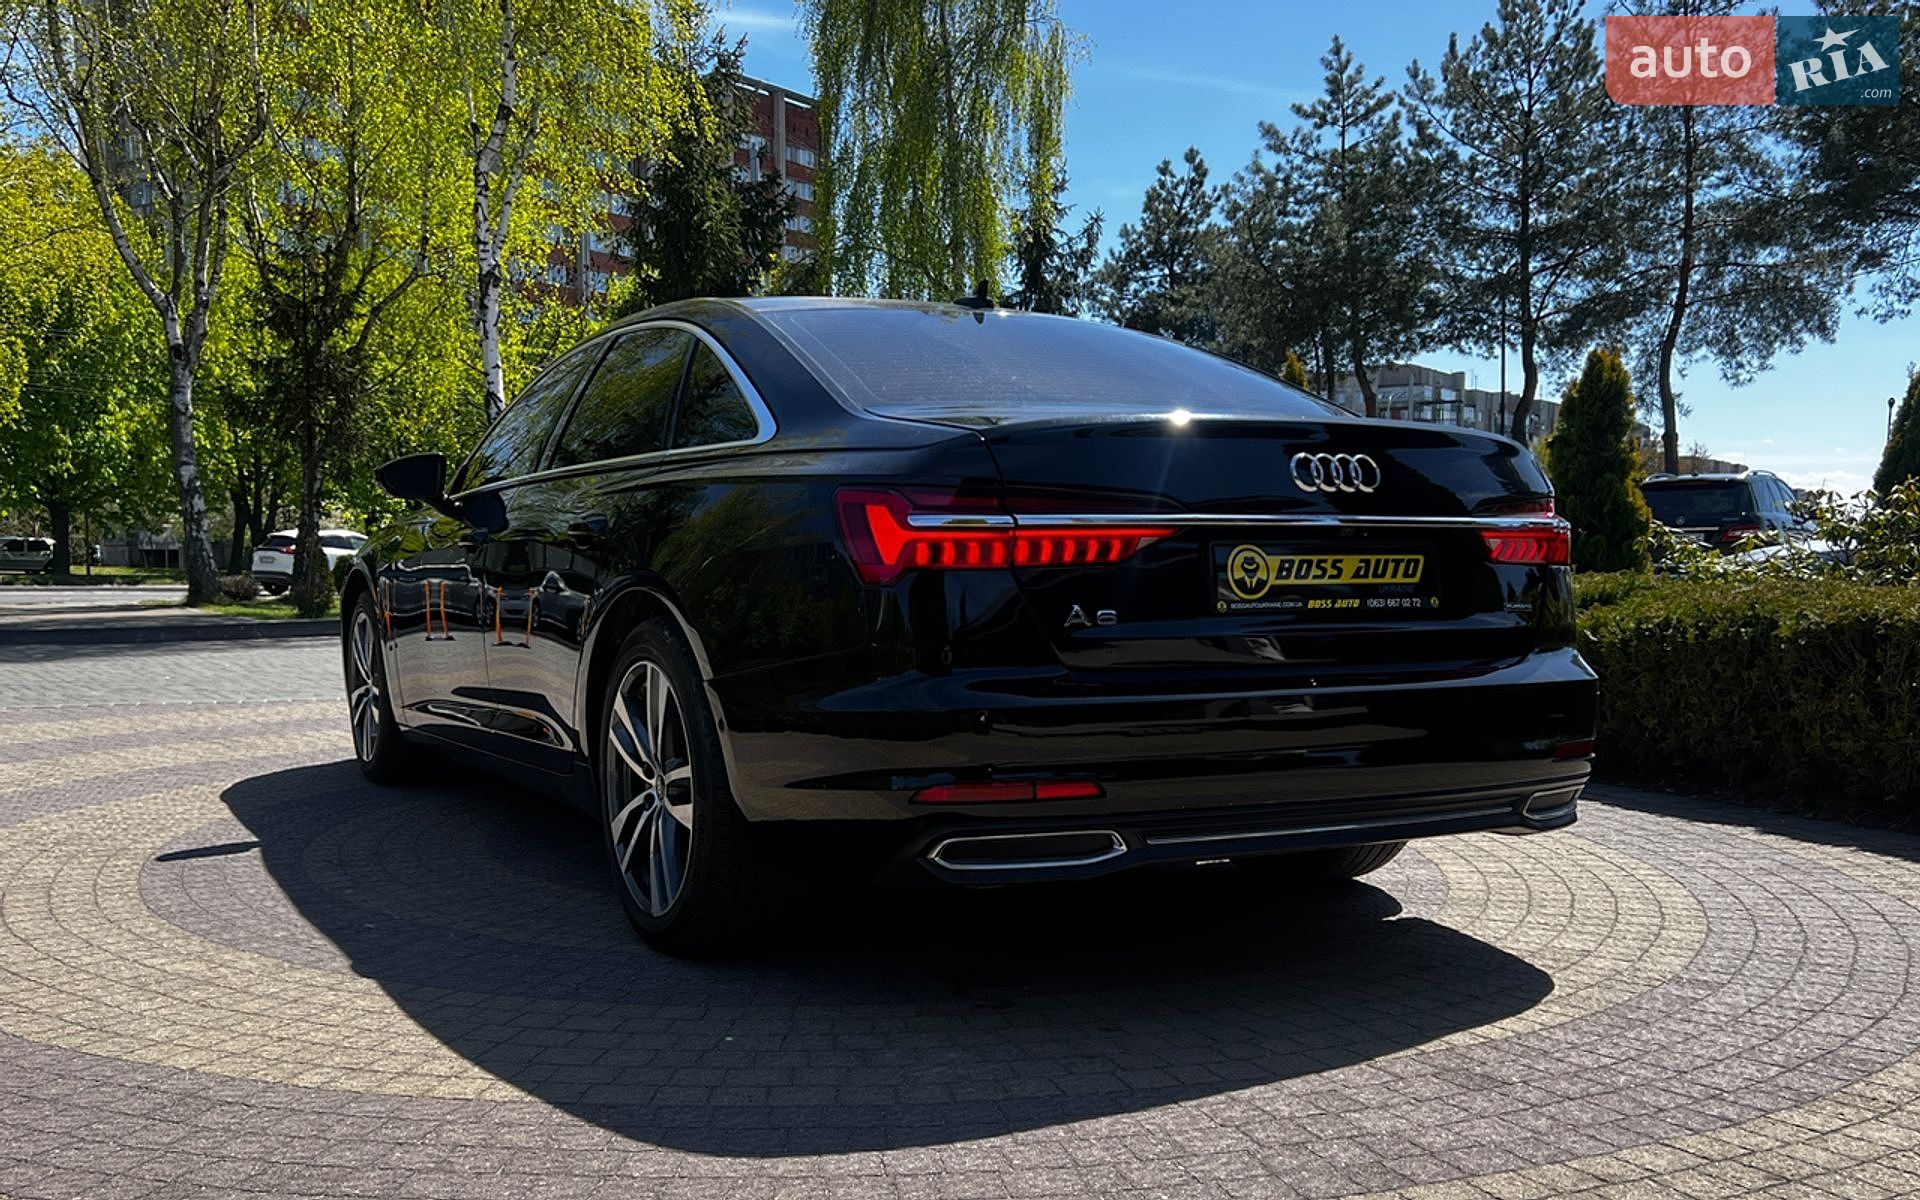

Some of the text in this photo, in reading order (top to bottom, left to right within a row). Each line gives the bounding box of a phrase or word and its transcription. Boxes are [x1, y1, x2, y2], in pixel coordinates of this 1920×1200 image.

[1275, 558, 1421, 580] BOSS AUTO
[1307, 599, 1360, 609] BOSS AUTO
[1063, 604, 1119, 627] A6
